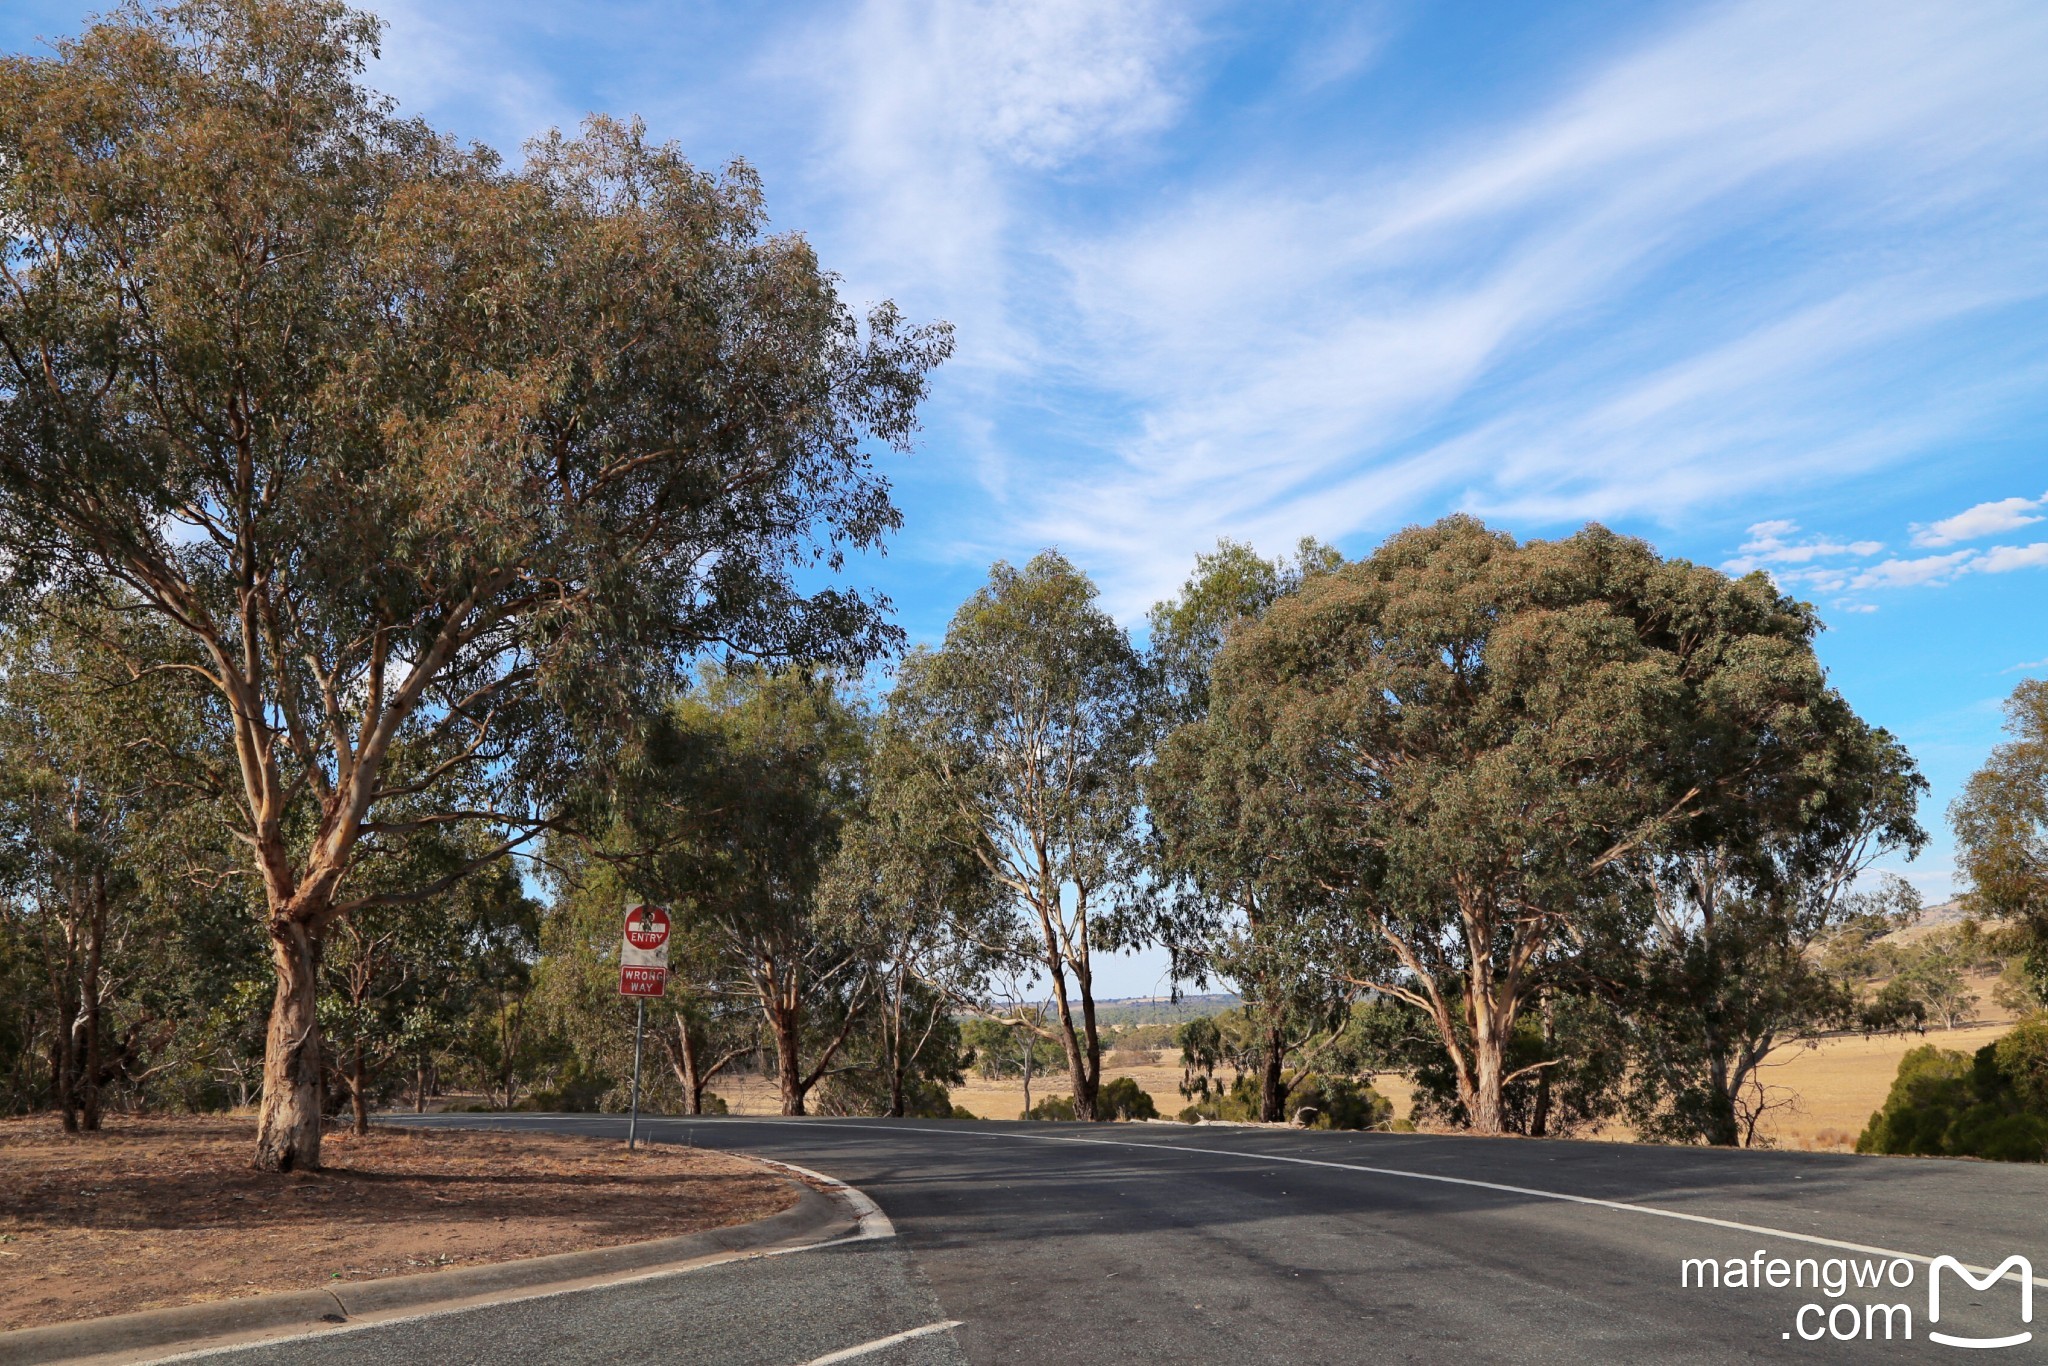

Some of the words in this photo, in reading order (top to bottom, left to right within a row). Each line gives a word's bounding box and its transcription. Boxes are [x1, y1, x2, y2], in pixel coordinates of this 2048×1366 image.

[631, 932, 663, 942] ENTRY
[625, 970, 662, 981] WRONG
[631, 982, 653, 992] WAY
